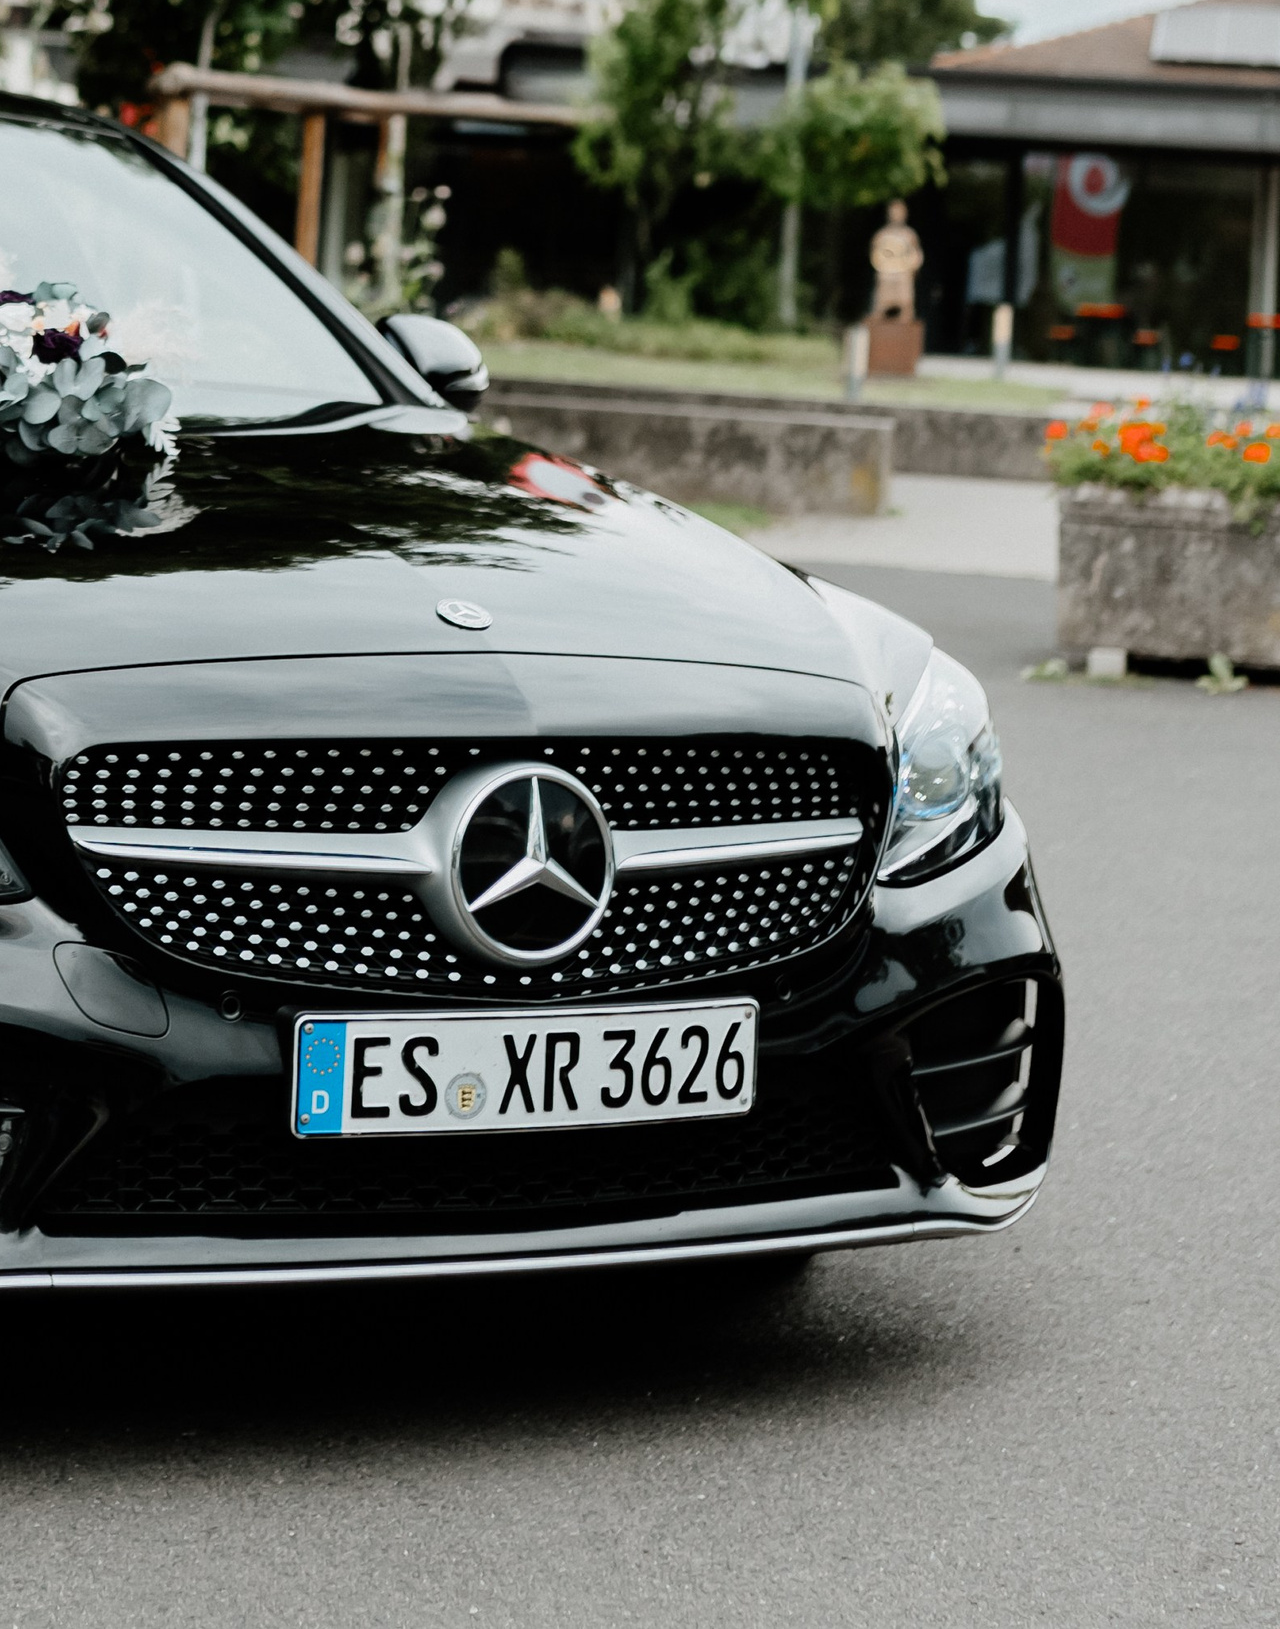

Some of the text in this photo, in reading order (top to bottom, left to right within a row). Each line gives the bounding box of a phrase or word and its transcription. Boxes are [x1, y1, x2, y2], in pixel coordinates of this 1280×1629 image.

[350, 1036, 440, 1119] ES
[498, 1031, 581, 1115] XR
[600, 1021, 745, 1109] 3626
[311, 1089, 330, 1115] D
